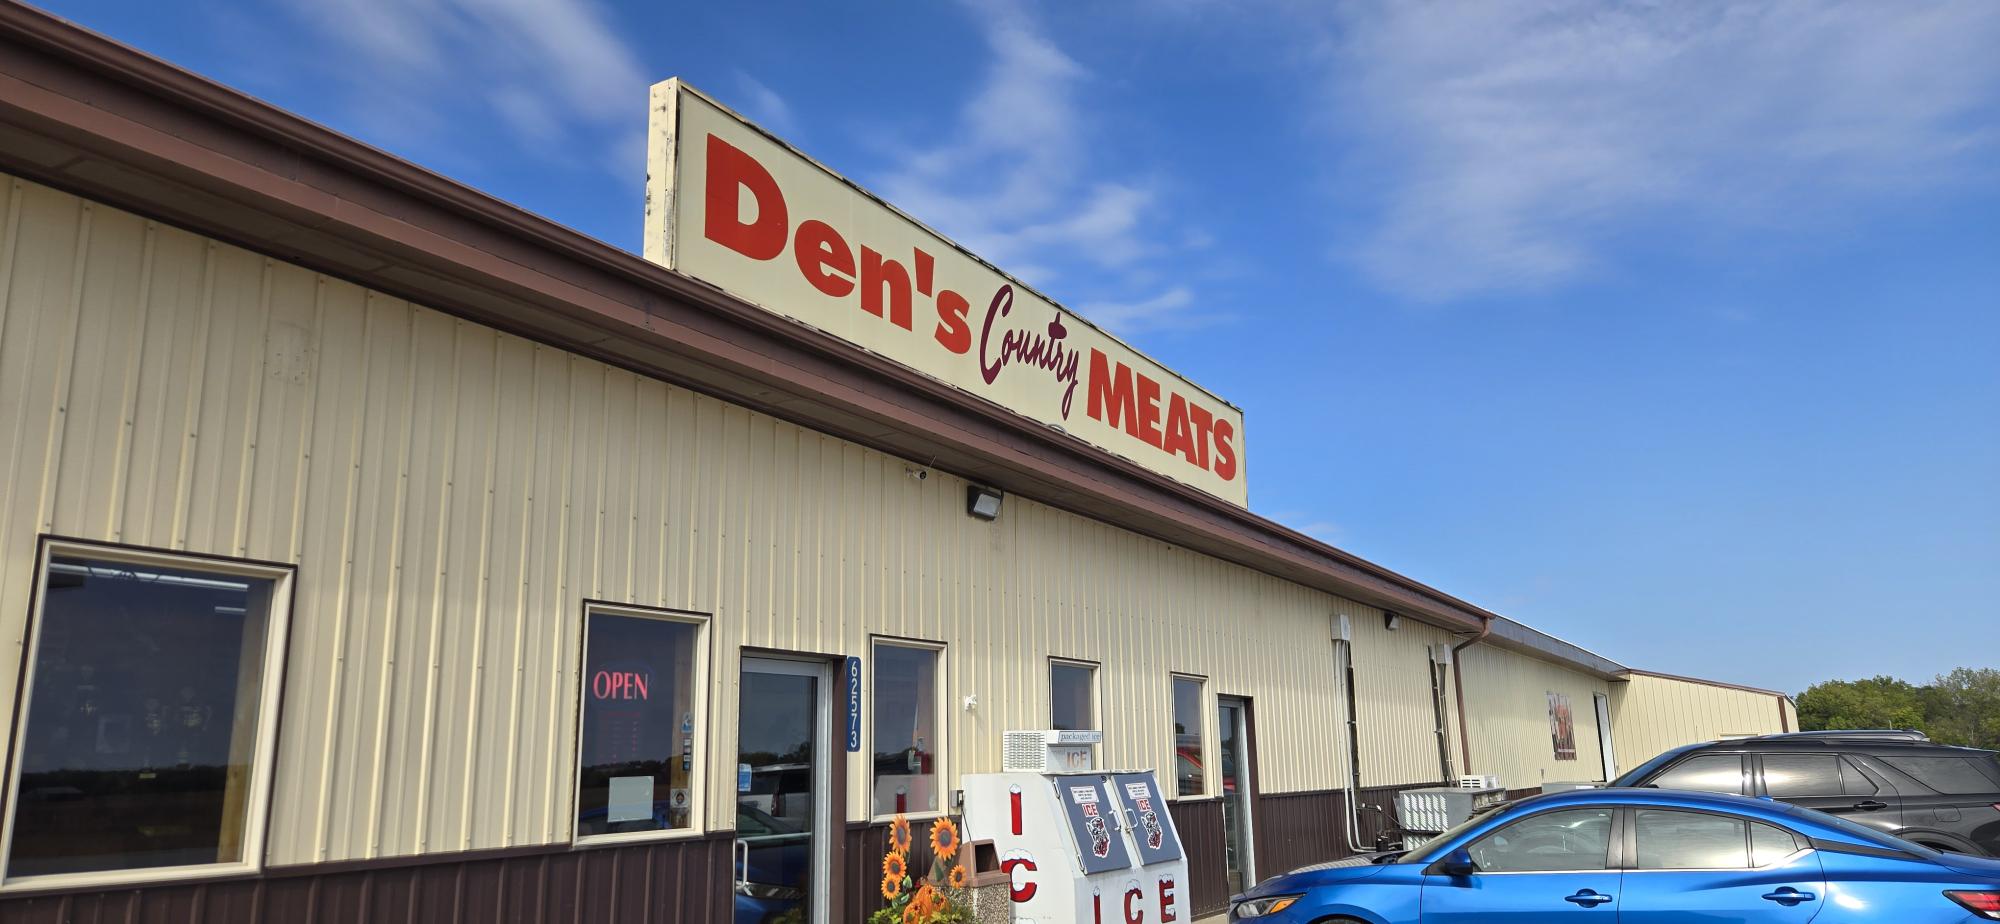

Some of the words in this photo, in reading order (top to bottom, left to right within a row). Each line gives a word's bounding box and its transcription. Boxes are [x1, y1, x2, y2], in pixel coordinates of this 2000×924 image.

[705, 132, 972, 355] Den's
[980, 284, 1079, 420] Country
[1087, 347, 1237, 481] MEATS
[593, 671, 648, 700] OPEN
[850, 660, 859, 748] 62573
[1083, 804, 1098, 816] ICE
[1136, 799, 1151, 811] ICE
[1092, 873, 1177, 924] ICE
